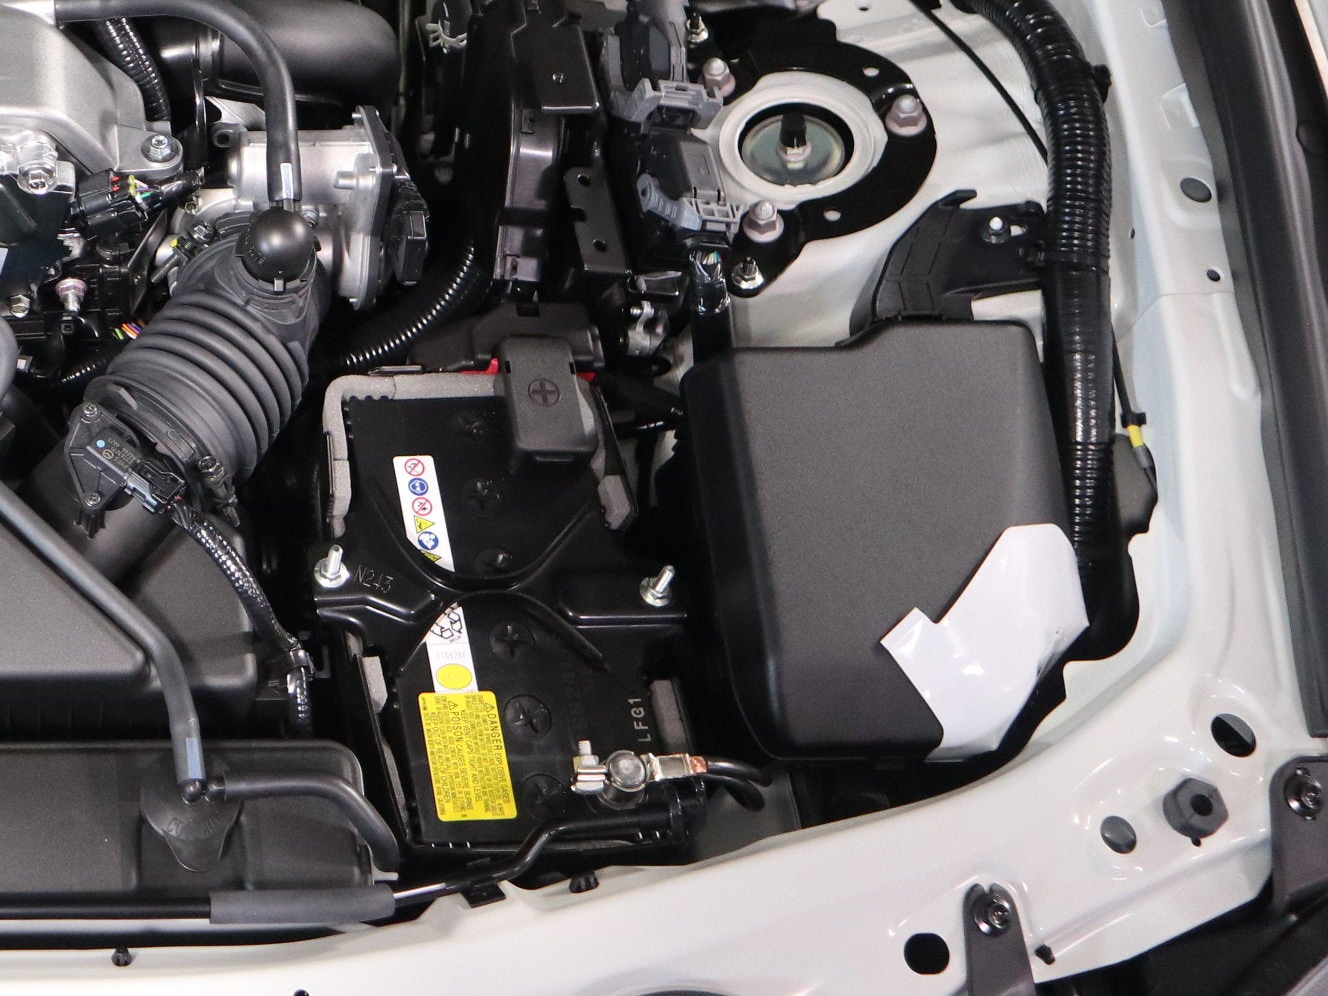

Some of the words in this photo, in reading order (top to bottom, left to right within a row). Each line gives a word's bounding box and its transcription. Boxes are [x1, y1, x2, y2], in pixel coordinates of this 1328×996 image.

[429, 712, 438, 725] KEEP
[460, 709, 468, 723] KEEP
[432, 726, 440, 737] OUT
[449, 711, 463, 741] POISON
[462, 724, 471, 738] VENT
[487, 713, 502, 750] DANGER
[455, 743, 466, 766] CAUSES
[465, 739, 474, 754] CAPS
[435, 747, 445, 766] REACH
[468, 755, 477, 771] TIGHT
[494, 752, 506, 783] EXPLOSIVE
[459, 767, 470, 789] SEVERE
[471, 773, 479, 784] AND
[440, 775, 451, 803] CHILDREN
[473, 785, 483, 802] LEVEL
[500, 784, 510, 803] GASES
[463, 790, 473, 810] BURNS
